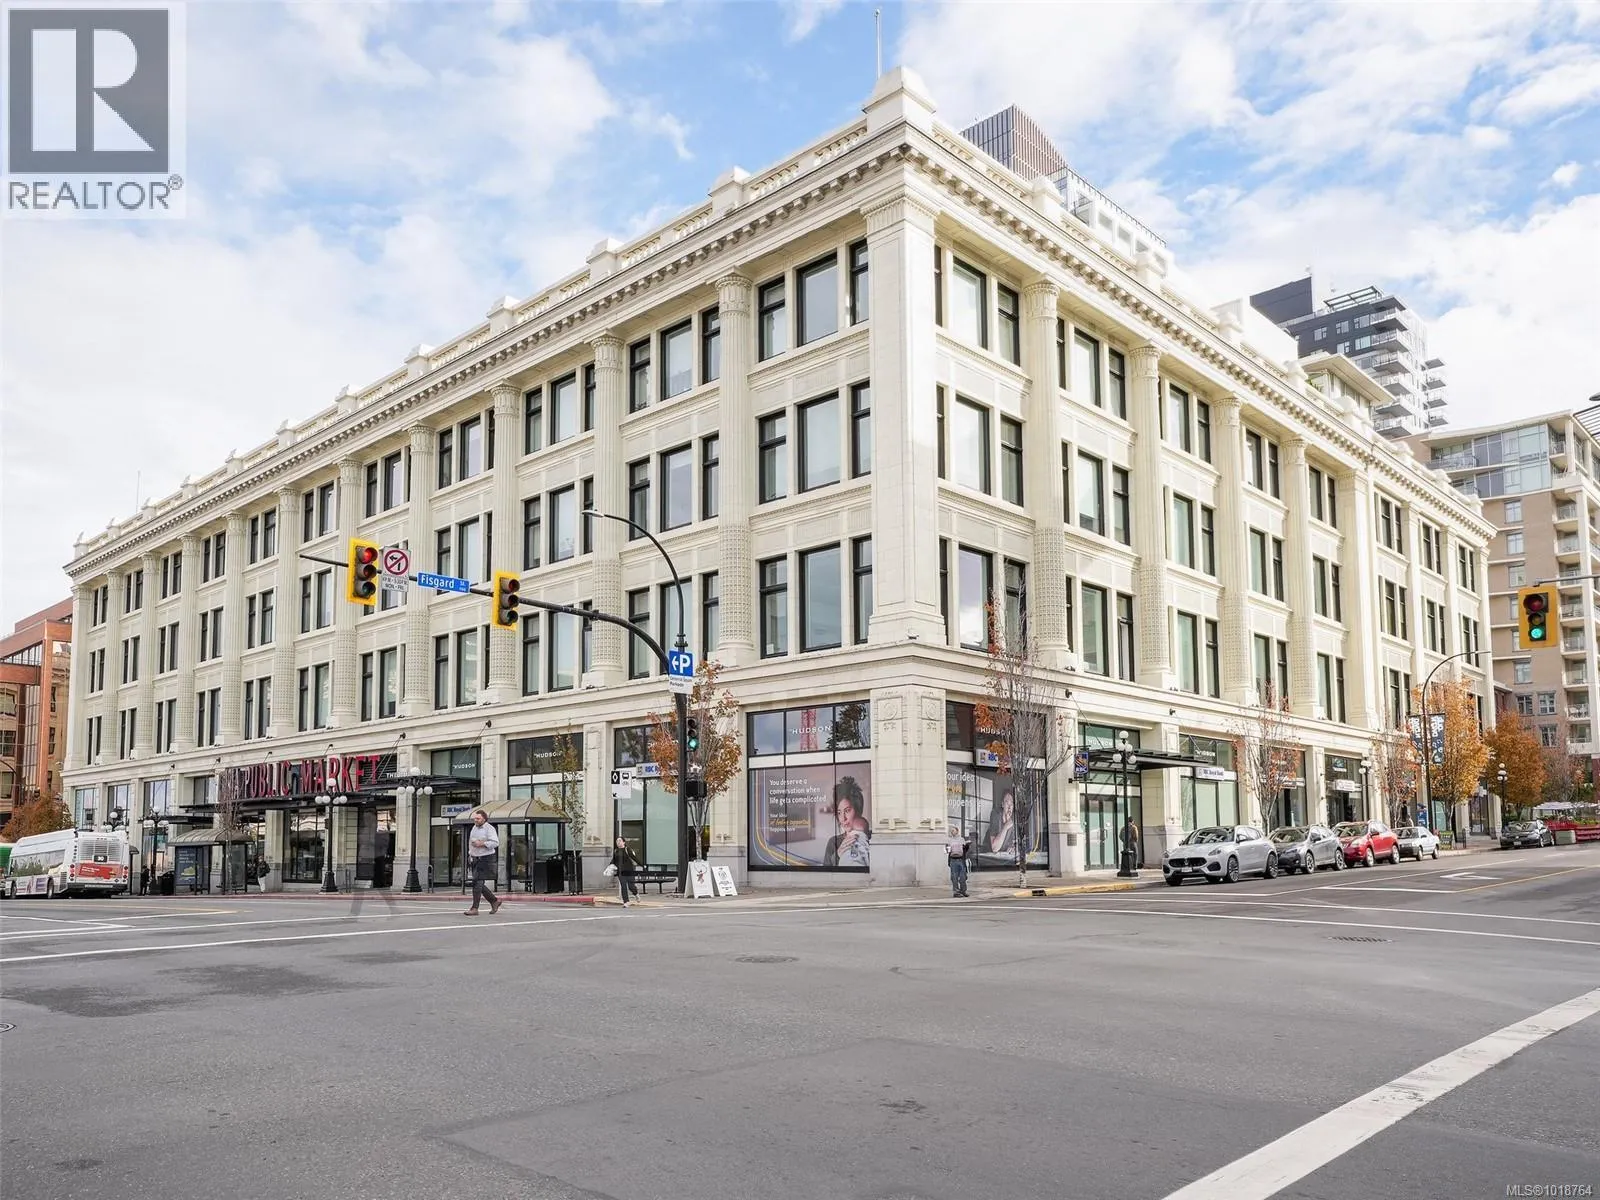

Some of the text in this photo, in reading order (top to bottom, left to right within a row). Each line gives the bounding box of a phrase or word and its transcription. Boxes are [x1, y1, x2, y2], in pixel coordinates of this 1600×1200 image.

[421, 574, 455, 589] Fisgard
[679, 654, 691, 674] P
[791, 725, 832, 735] HUDSON
[243, 760, 292, 799] PUBLIC
[302, 754, 381, 794] MARKET
